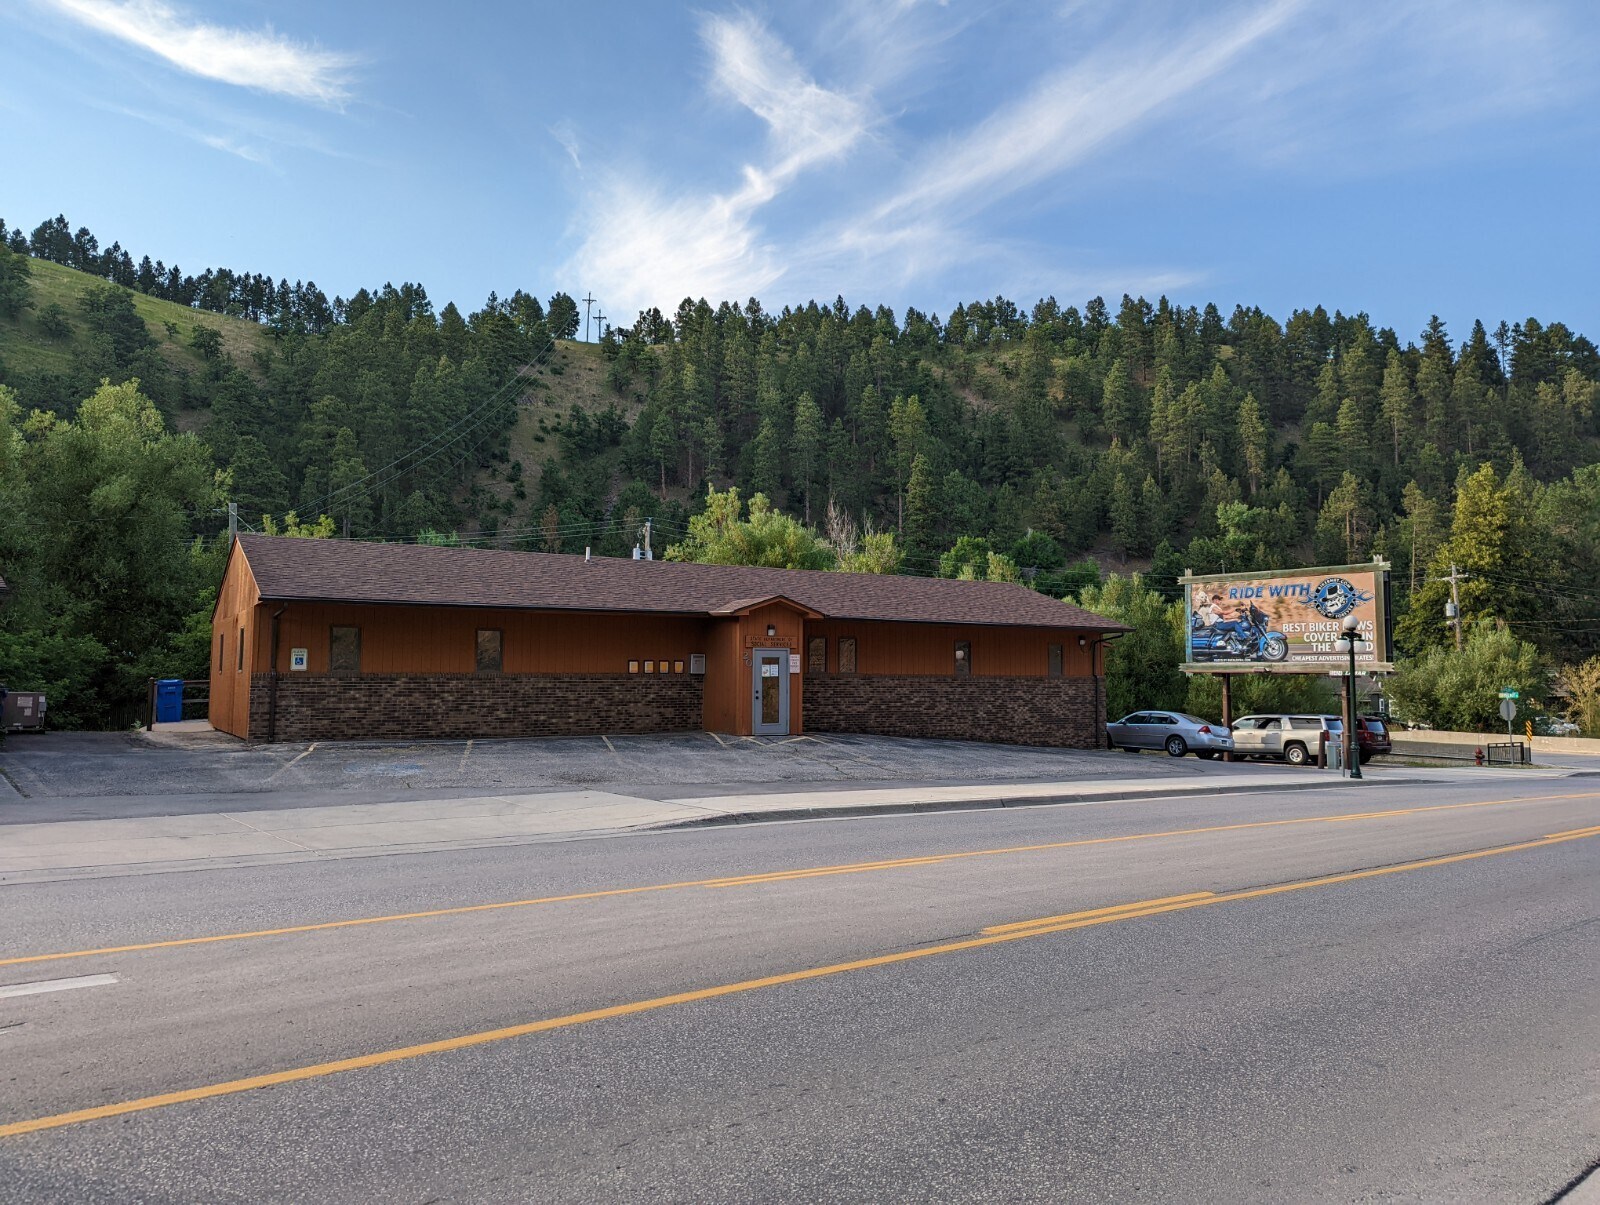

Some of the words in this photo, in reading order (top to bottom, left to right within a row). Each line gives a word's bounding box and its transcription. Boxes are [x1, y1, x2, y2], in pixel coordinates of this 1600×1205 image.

[1229, 586, 1264, 599] RIDE
[1269, 583, 1311, 597] WITH
[1282, 622, 1306, 633] BEST
[1309, 621, 1339, 632] BIKER
[1343, 620, 1373, 631] WS
[1312, 642, 1331, 652] THE
